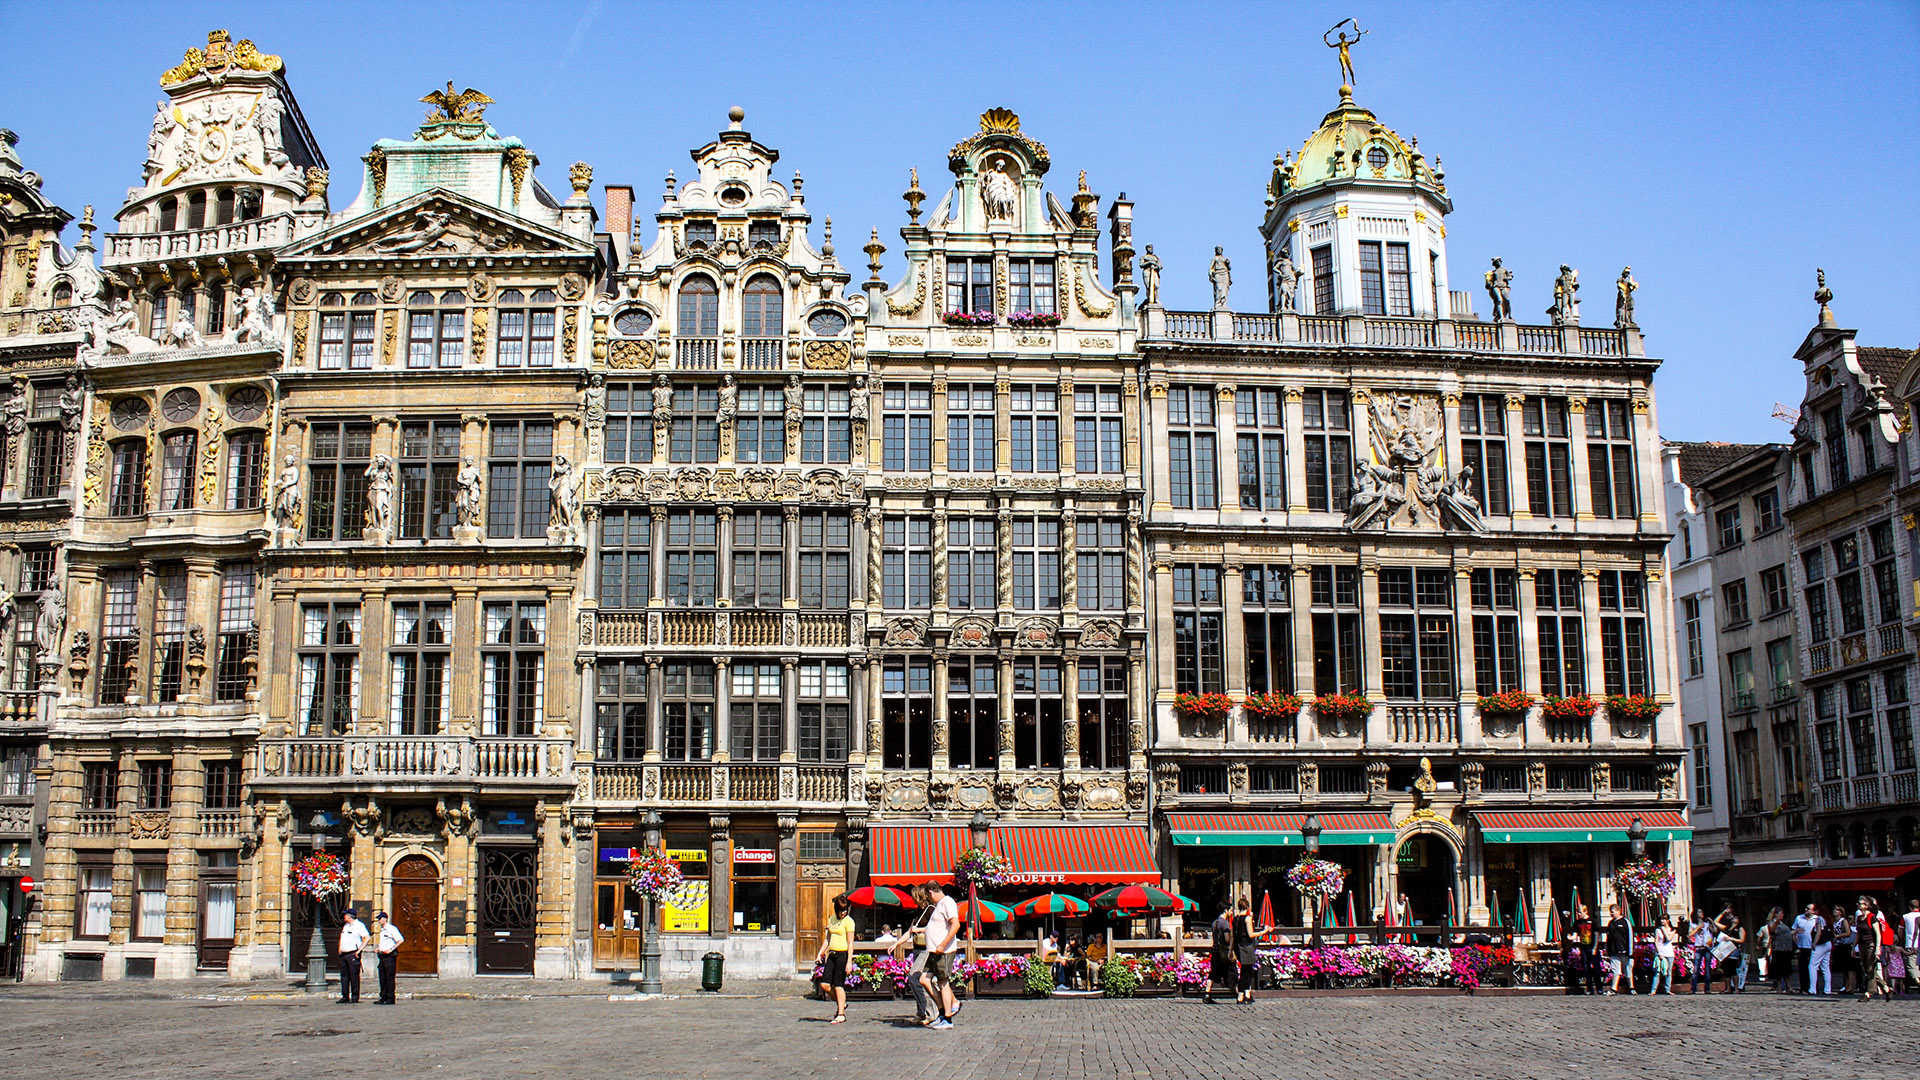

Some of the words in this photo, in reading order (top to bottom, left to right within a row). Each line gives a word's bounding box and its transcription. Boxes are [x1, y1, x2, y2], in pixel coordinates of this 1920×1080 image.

[721, 165, 747, 176] 1697
[736, 850, 773, 861] change
[1257, 866, 1286, 876] Jupiler
